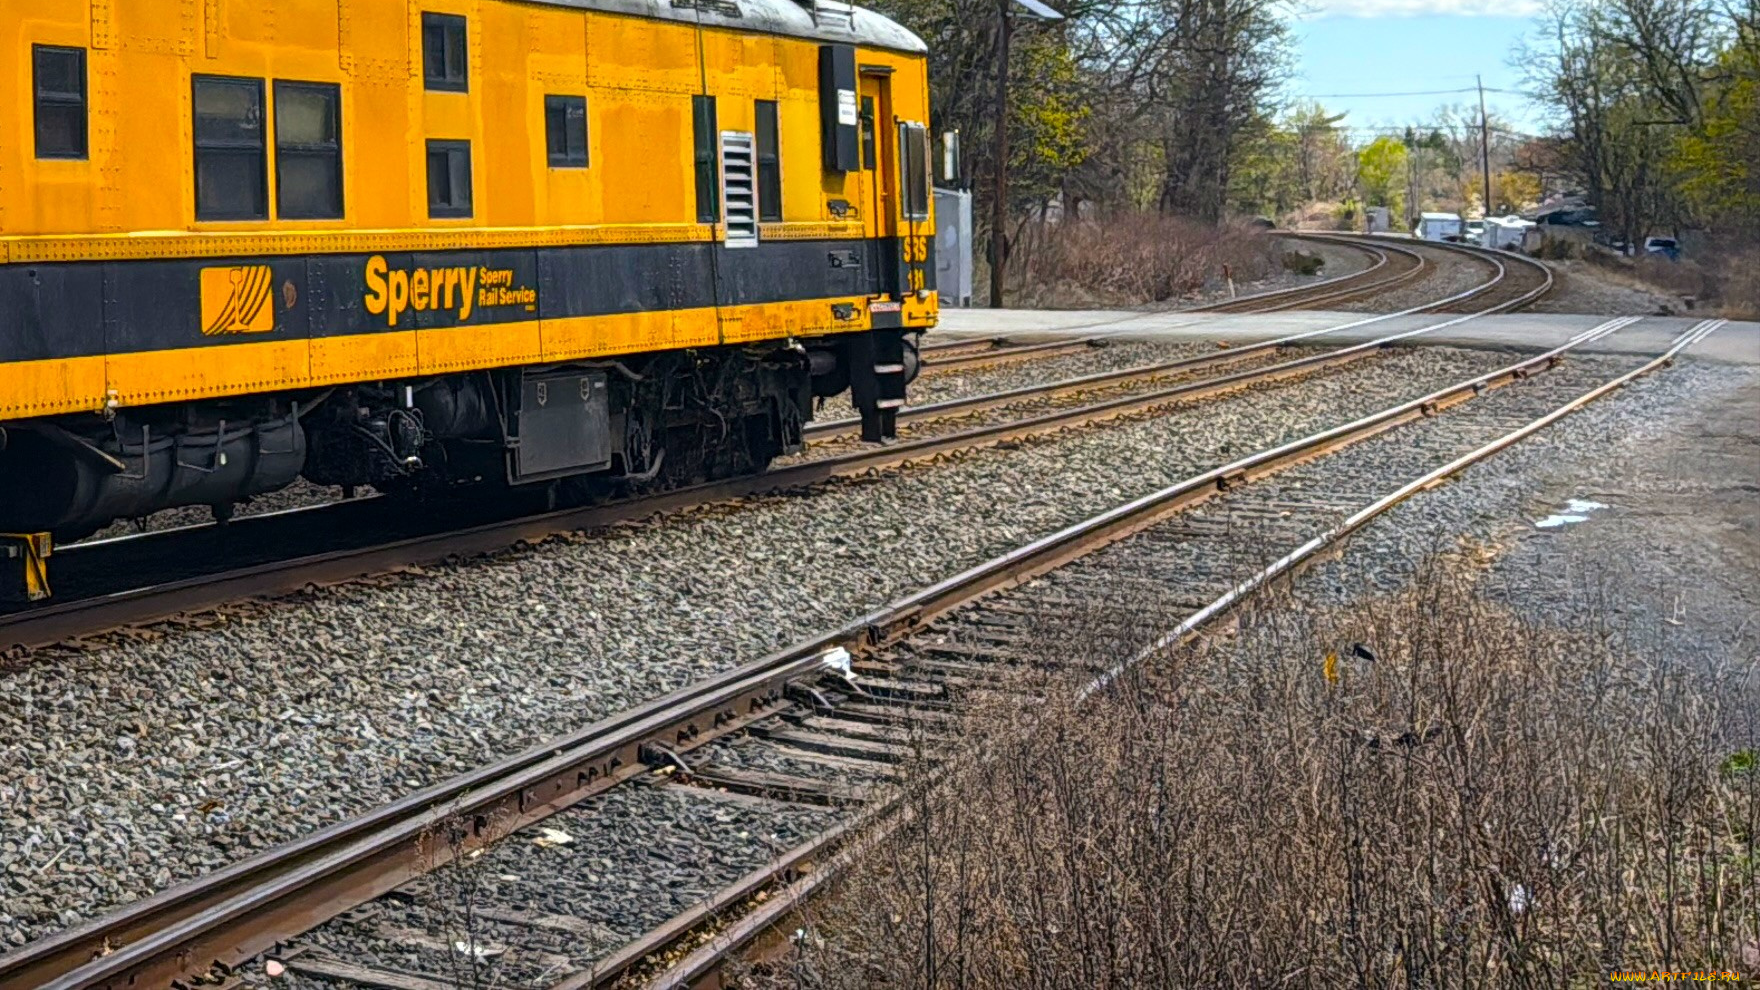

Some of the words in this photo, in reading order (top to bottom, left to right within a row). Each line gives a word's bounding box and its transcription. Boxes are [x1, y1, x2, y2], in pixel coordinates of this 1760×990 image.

[479, 266, 513, 288] Sperry
[364, 254, 478, 327] Sperry
[478, 288, 498, 306] Rail
[499, 285, 536, 305] Service
